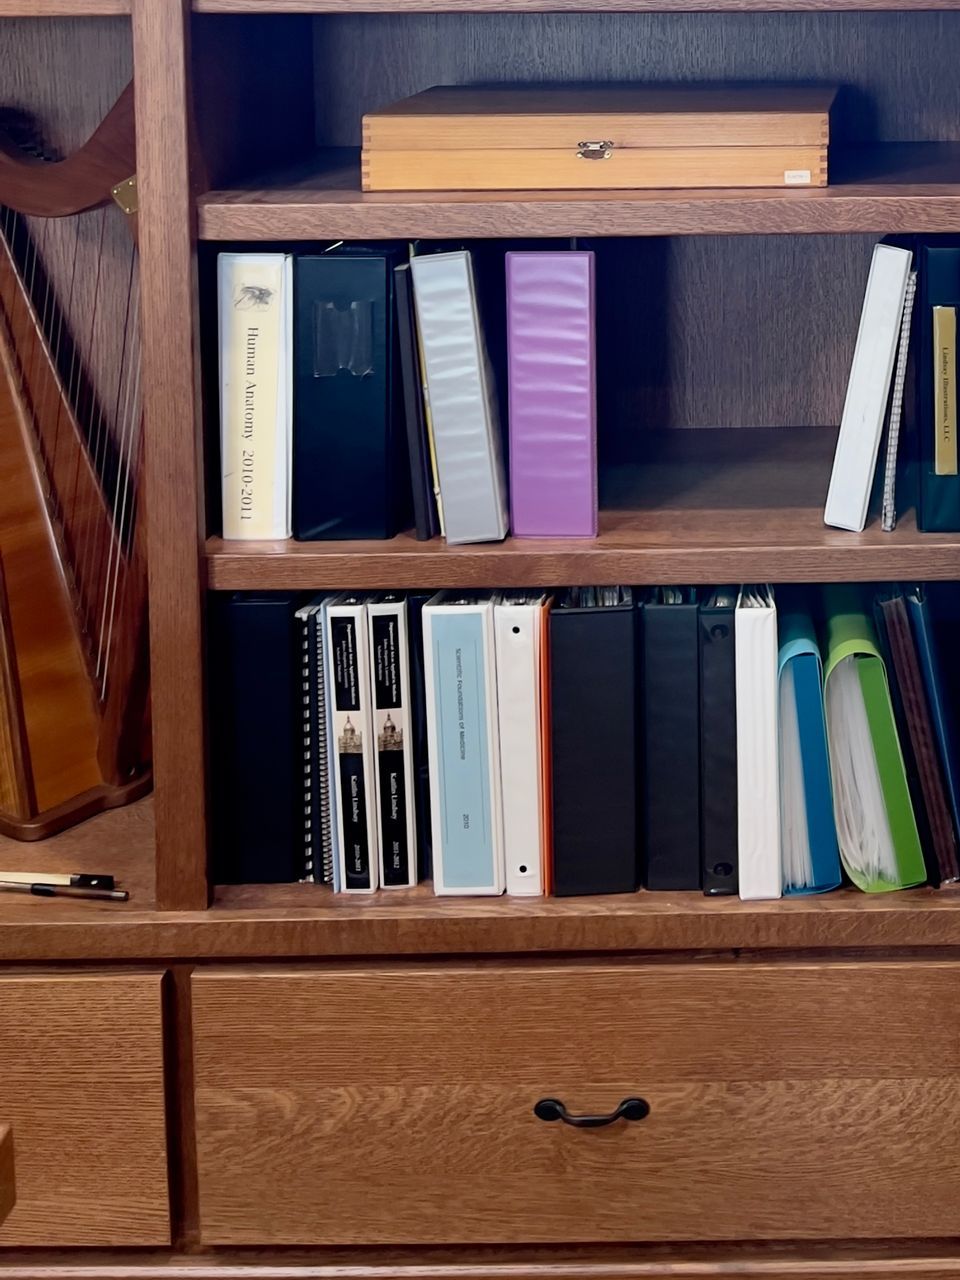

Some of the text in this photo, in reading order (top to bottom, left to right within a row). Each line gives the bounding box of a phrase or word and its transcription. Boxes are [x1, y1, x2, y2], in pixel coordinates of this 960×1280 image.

[941, 347, 949, 375] Lindsay
[240, 327, 259, 521] Human Anatomy 2010-2011
[455, 648, 464, 679] Scientific
[456, 680, 465, 720] Foundations
[459, 731, 467, 760] Medicine
[390, 772, 399, 820] Kaitlin Lindsay
